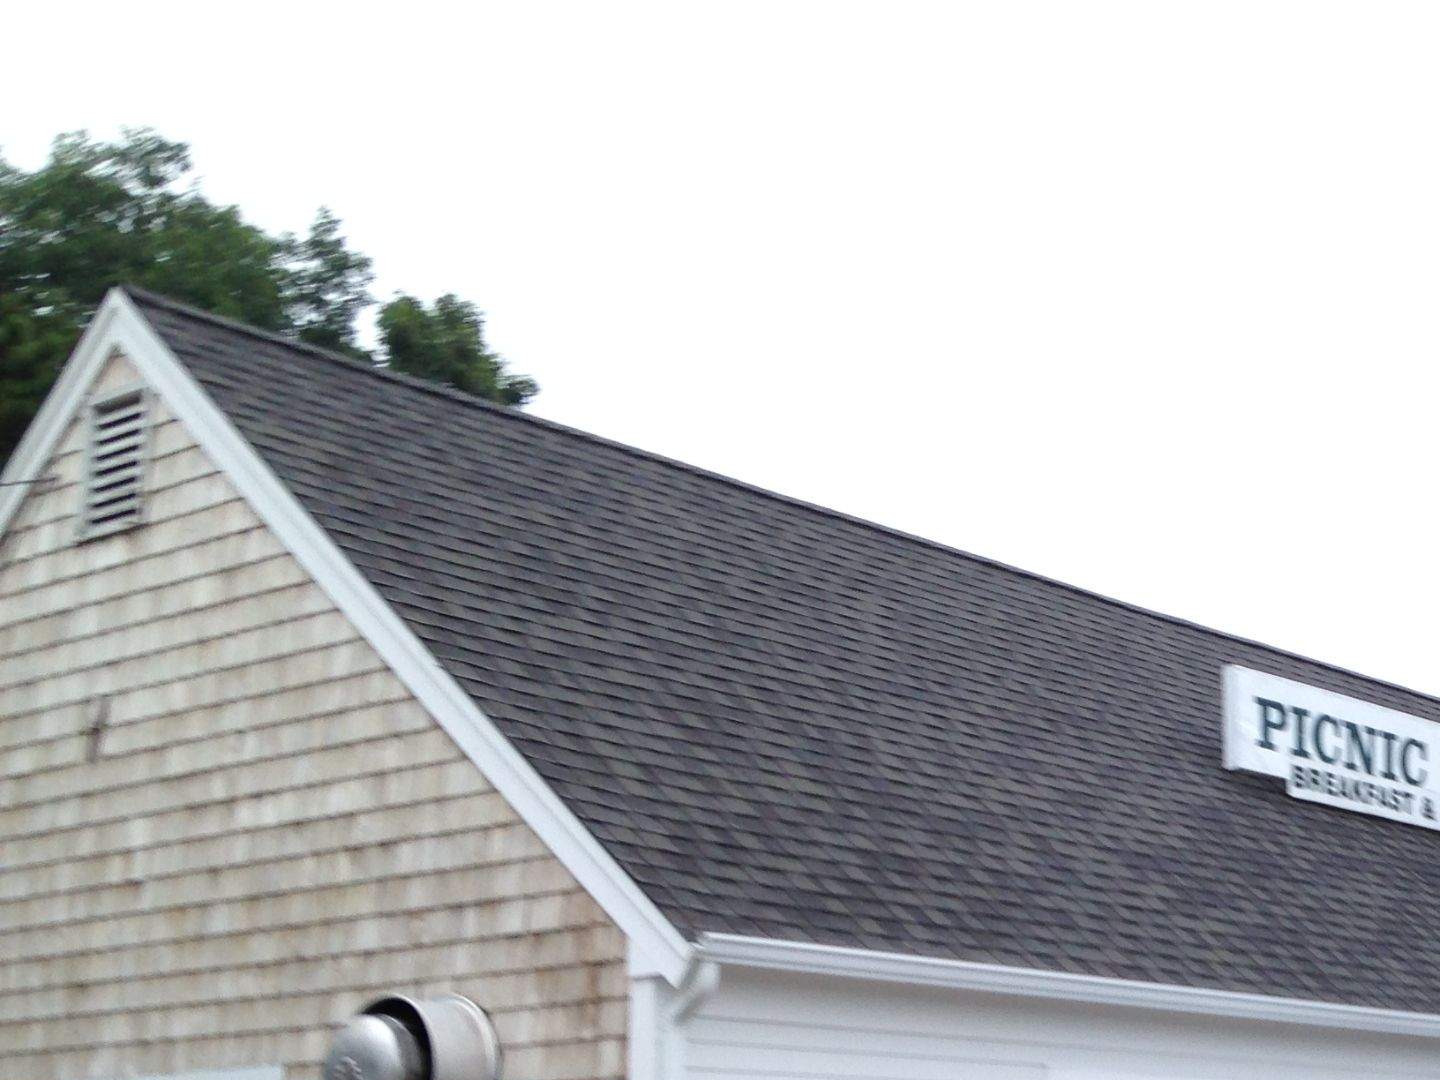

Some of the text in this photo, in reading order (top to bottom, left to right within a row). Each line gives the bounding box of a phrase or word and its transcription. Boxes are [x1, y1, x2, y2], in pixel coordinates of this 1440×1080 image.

[1253, 696, 1428, 787] PICNIC
[1290, 764, 1414, 816] BREAKFAST
[1422, 797, 1438, 822] &
